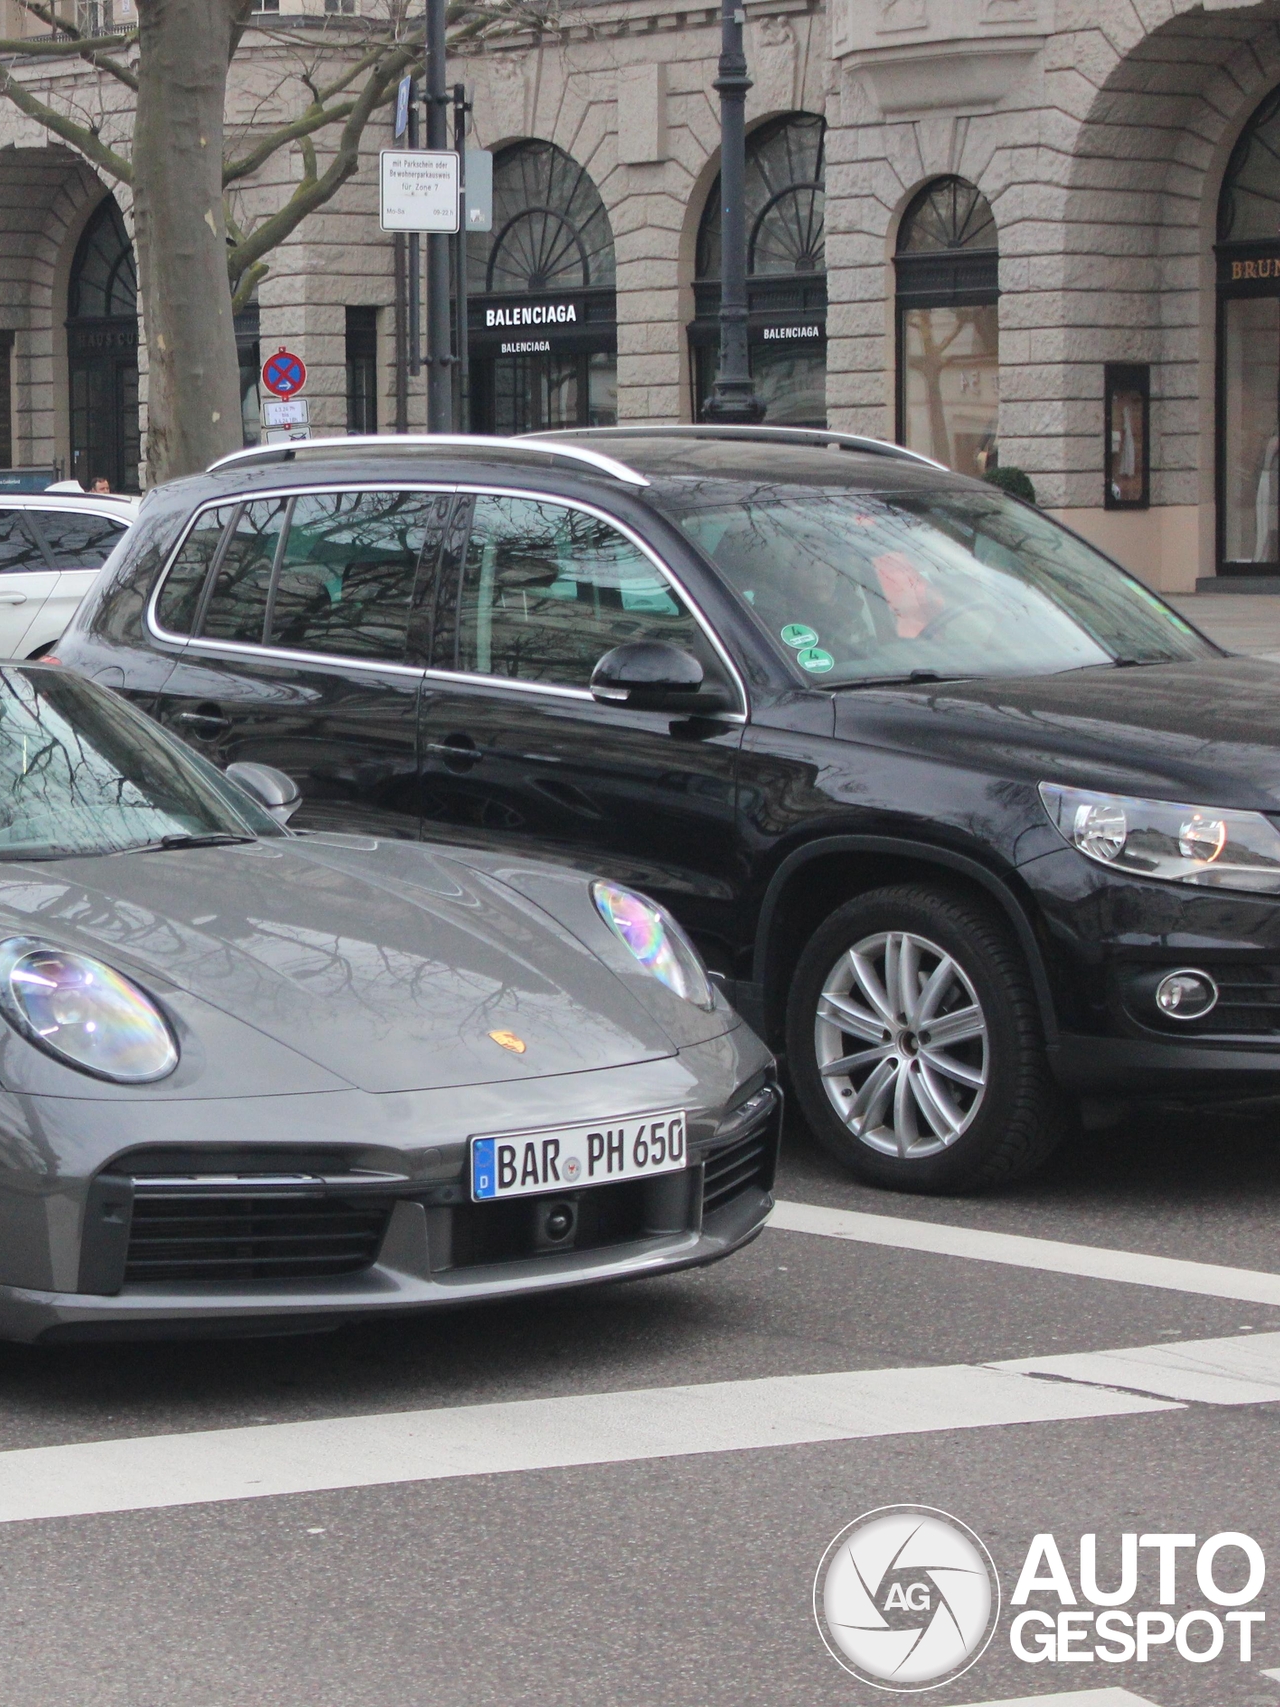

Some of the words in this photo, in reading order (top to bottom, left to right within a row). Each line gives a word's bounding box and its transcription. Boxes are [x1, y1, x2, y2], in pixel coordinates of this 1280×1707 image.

[404, 160, 434, 168] Parkschein
[486, 304, 576, 327] BALENCIAGA
[763, 326, 820, 340] BALENCIAGA
[501, 341, 550, 354] BALENCIAGA
[791, 626, 802, 636] 4
[808, 650, 818, 660] 4
[498, 1138, 560, 1189] BAR
[587, 1128, 624, 1176] PH
[633, 1119, 683, 1168] 650
[480, 1175, 488, 1188] D
